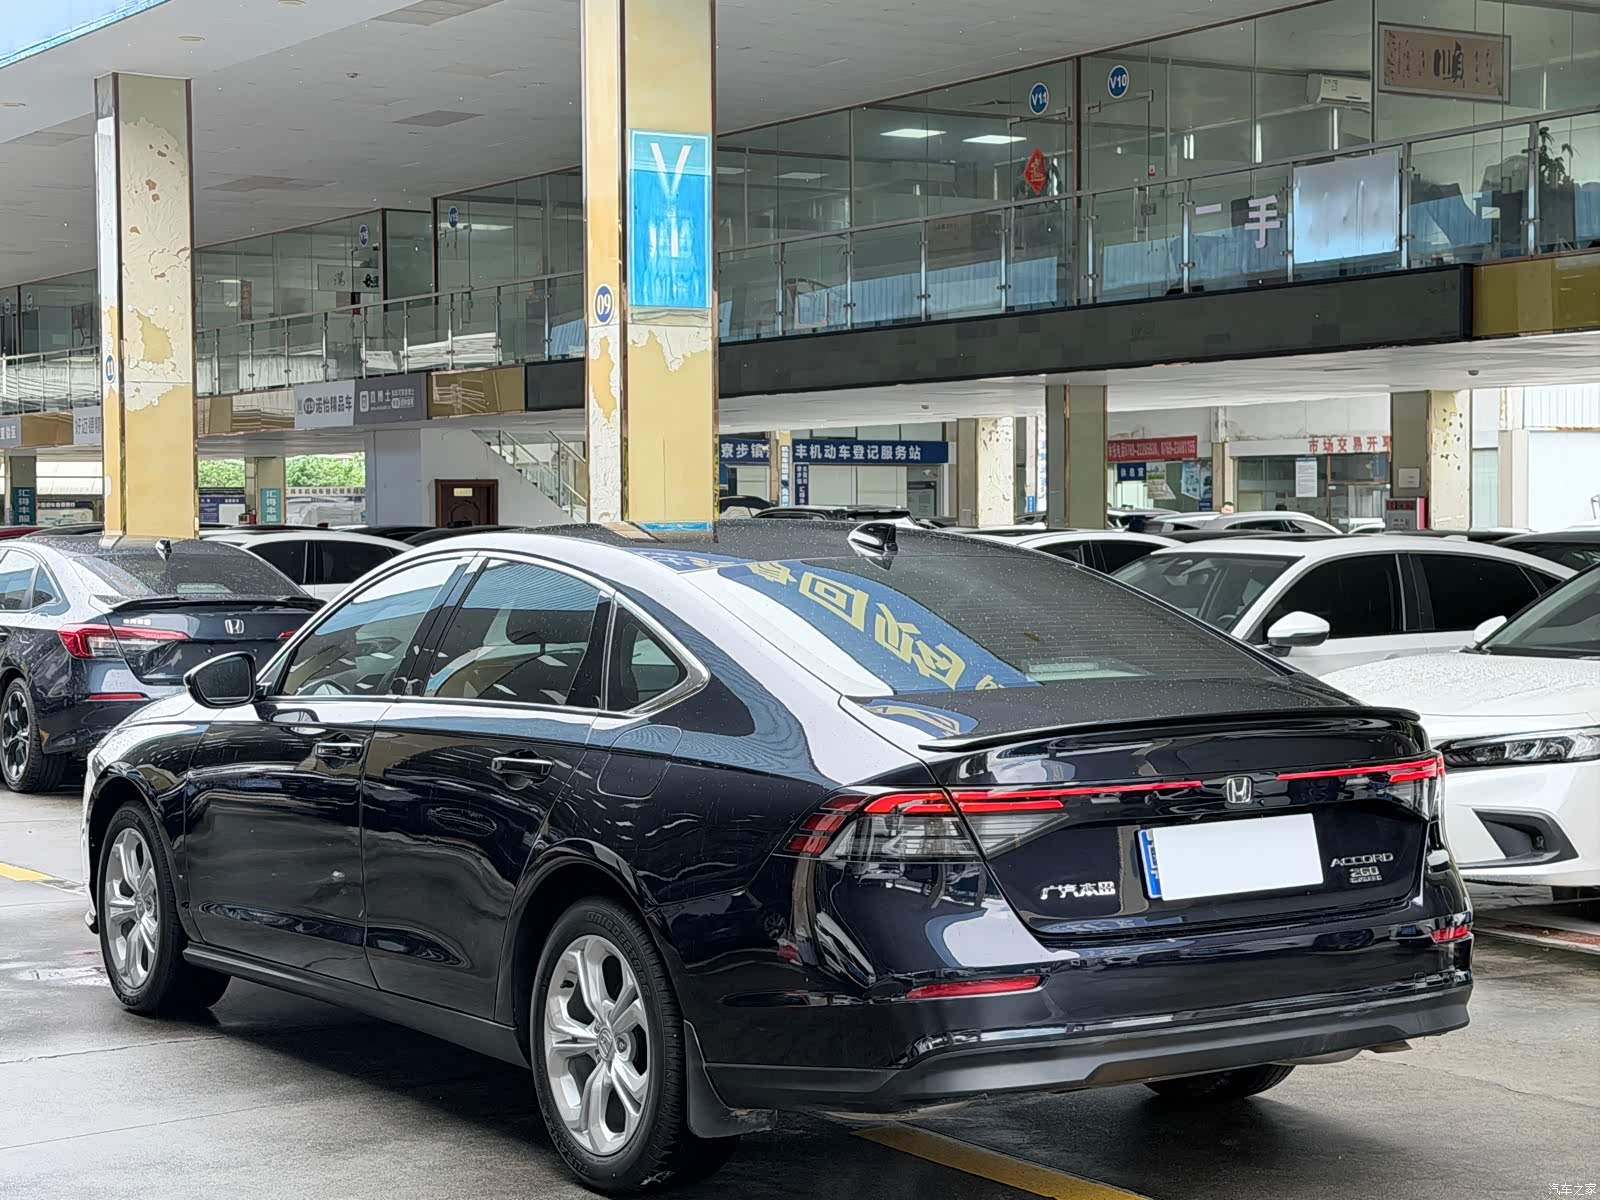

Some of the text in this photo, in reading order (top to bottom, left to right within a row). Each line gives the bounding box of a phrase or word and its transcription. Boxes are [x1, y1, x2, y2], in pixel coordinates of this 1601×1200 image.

[1109, 74, 1127, 89] V10
[1031, 91, 1048, 106] V11
[597, 293, 611, 316] 09
[720, 443, 922, 461] 寮步镇 丰机动车登记服务站
[1330, 852, 1394, 868] ACCORD
[1349, 866, 1380, 878] 260
[1040, 881, 1116, 900] 广汽本田
